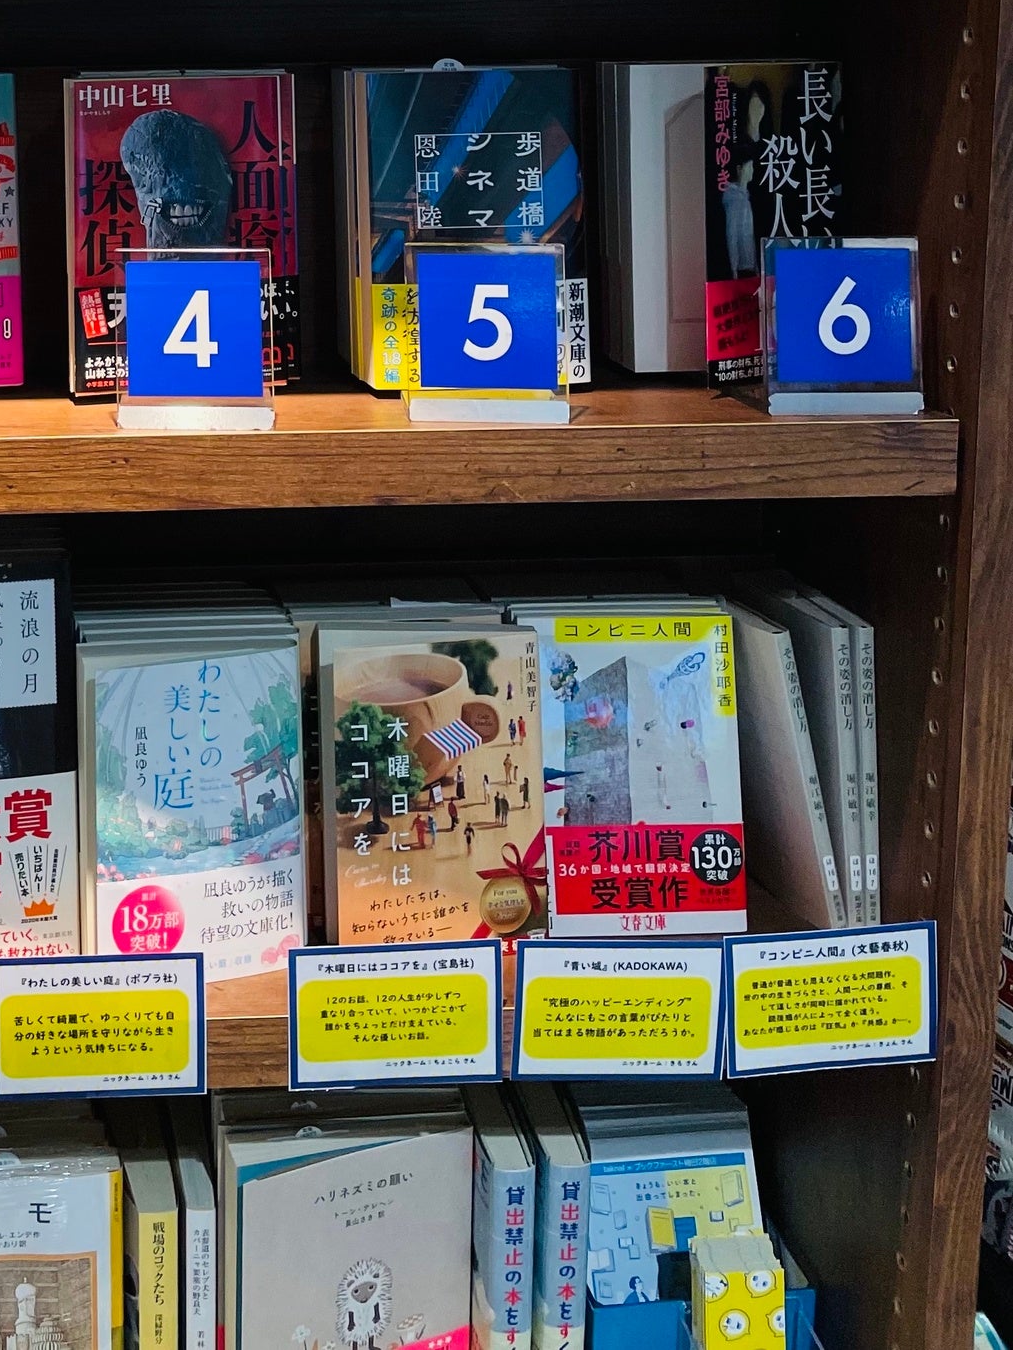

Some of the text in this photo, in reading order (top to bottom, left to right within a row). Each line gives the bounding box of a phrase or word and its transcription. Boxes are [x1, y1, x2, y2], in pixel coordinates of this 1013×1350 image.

[78, 83, 173, 109] 中山七里
[713, 73, 731, 193] 宮部みゆき
[414, 134, 442, 228] 恩田陸
[465, 134, 495, 228] シネマ
[515, 132, 544, 227] 歩道橋
[758, 133, 801, 250] 殺人
[162, 289, 219, 368] 4
[462, 283, 514, 362] 5
[568, 280, 587, 378] 新潮文庫の
[818, 275, 871, 355] 6
[380, 287, 402, 385] 奇跡の全18編
[19, 590, 40, 695] 流浪の月
[563, 621, 692, 639] コンビニ人間
[524, 641, 538, 713] 青山美智子
[713, 623, 731, 708] 村田沙耶香
[198, 659, 222, 769] わたしの
[134, 726, 148, 788] 凪良ゆう
[153, 684, 194, 812] 美しい庭
[350, 723, 372, 857] ココアを
[386, 717, 412, 886] 木曜日には
[587, 828, 686, 863] 芥川賞
[704, 833, 726, 845] 累計
[14, 852, 30, 897] 売りたい本
[691, 846, 733, 870] 130
[706, 869, 729, 882] 突破
[203, 867, 294, 899] 凪良ゆうが描く
[369, 888, 447, 912] わたしたちは、
[590, 875, 688, 910] 受賞作
[120, 904, 180, 934] 18万部
[221, 890, 294, 918] 救いの物語
[352, 901, 470, 935] 知らないうちに誰かを
[129, 928, 169, 953] 突破!
[200, 911, 294, 944] 待望の文庫化!
[619, 914, 667, 932] 文春文庫
[13, 1010, 175, 1027] 苦しくて綺麗で、ゆっくりでも自
[319, 1003, 468, 1020] 重なり合っていて、いつかどこかで
[13, 1025, 175, 1042] 分の好きな場所を守りながら生き
[30, 1041, 155, 1056] ようという気持ちになる。
[352, 1031, 431, 1043] そんな優しいお話。
[532, 1027, 696, 1038] 当てはまる物語があっただろうか。
[313, 1171, 414, 1206] ハリネズミの願い
[152, 1221, 165, 1306] 戦場のコックたち
